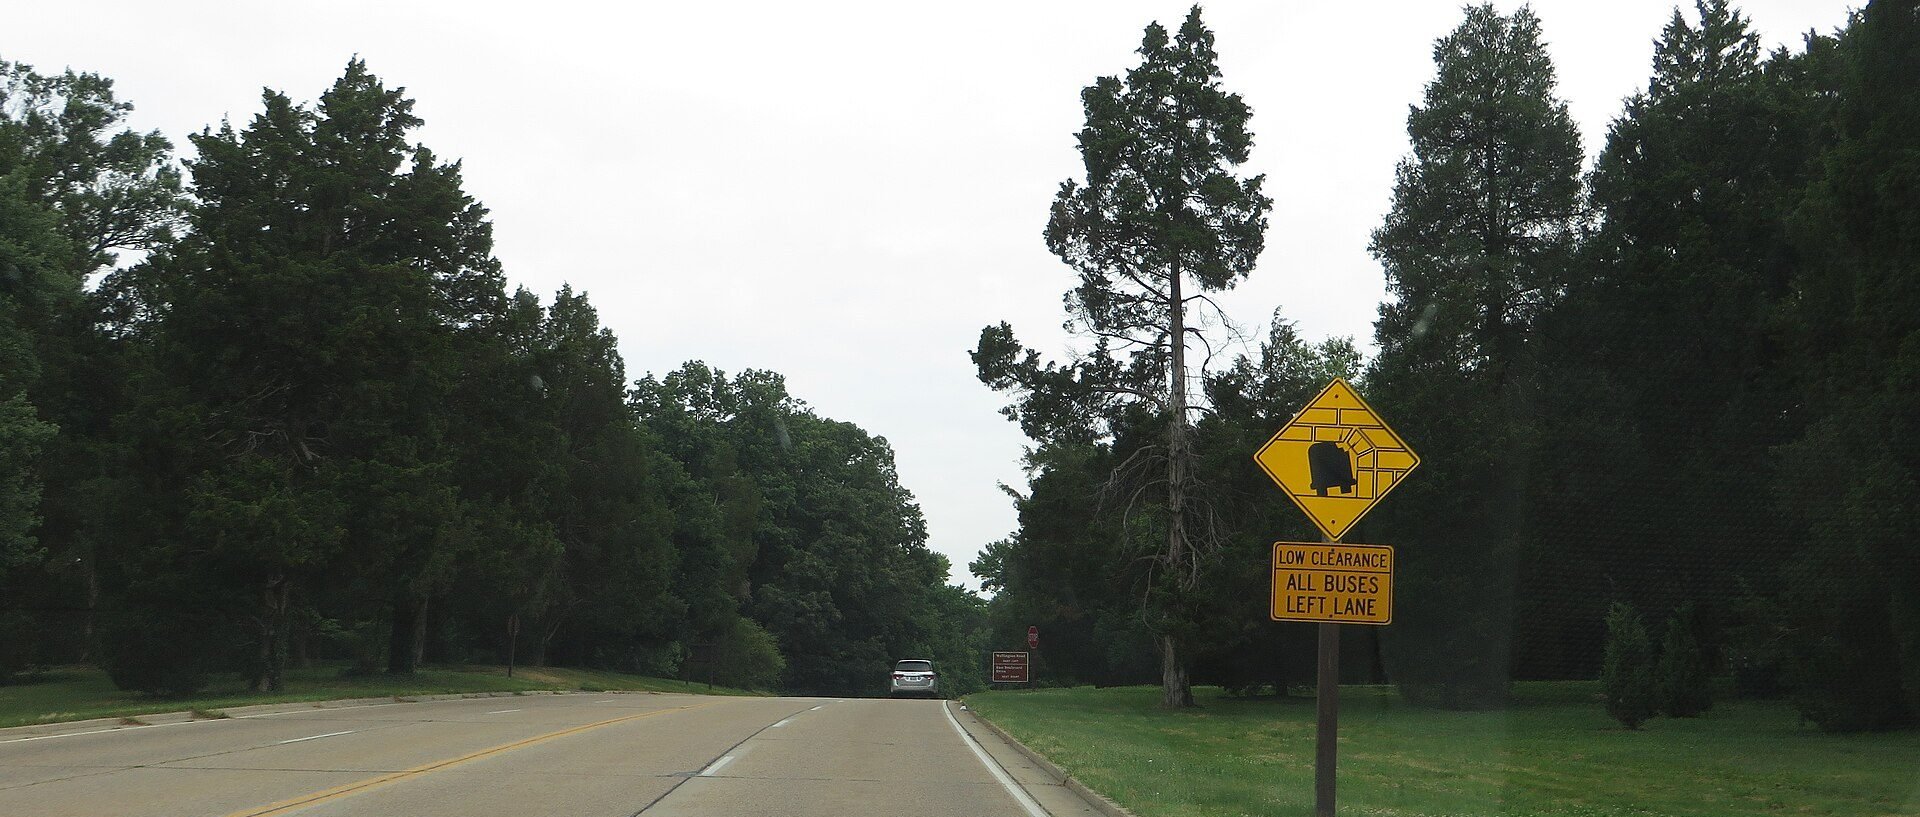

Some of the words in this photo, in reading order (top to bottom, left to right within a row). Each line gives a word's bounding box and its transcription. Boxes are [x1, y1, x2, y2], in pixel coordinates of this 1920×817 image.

[1279, 550, 1305, 564] LOW
[1311, 551, 1387, 568] CLEARANCE
[1286, 573, 1316, 591] ALL
[1324, 574, 1379, 594] BUSES
[1286, 595, 1326, 614] LEFT
[1334, 597, 1377, 616] LANE
